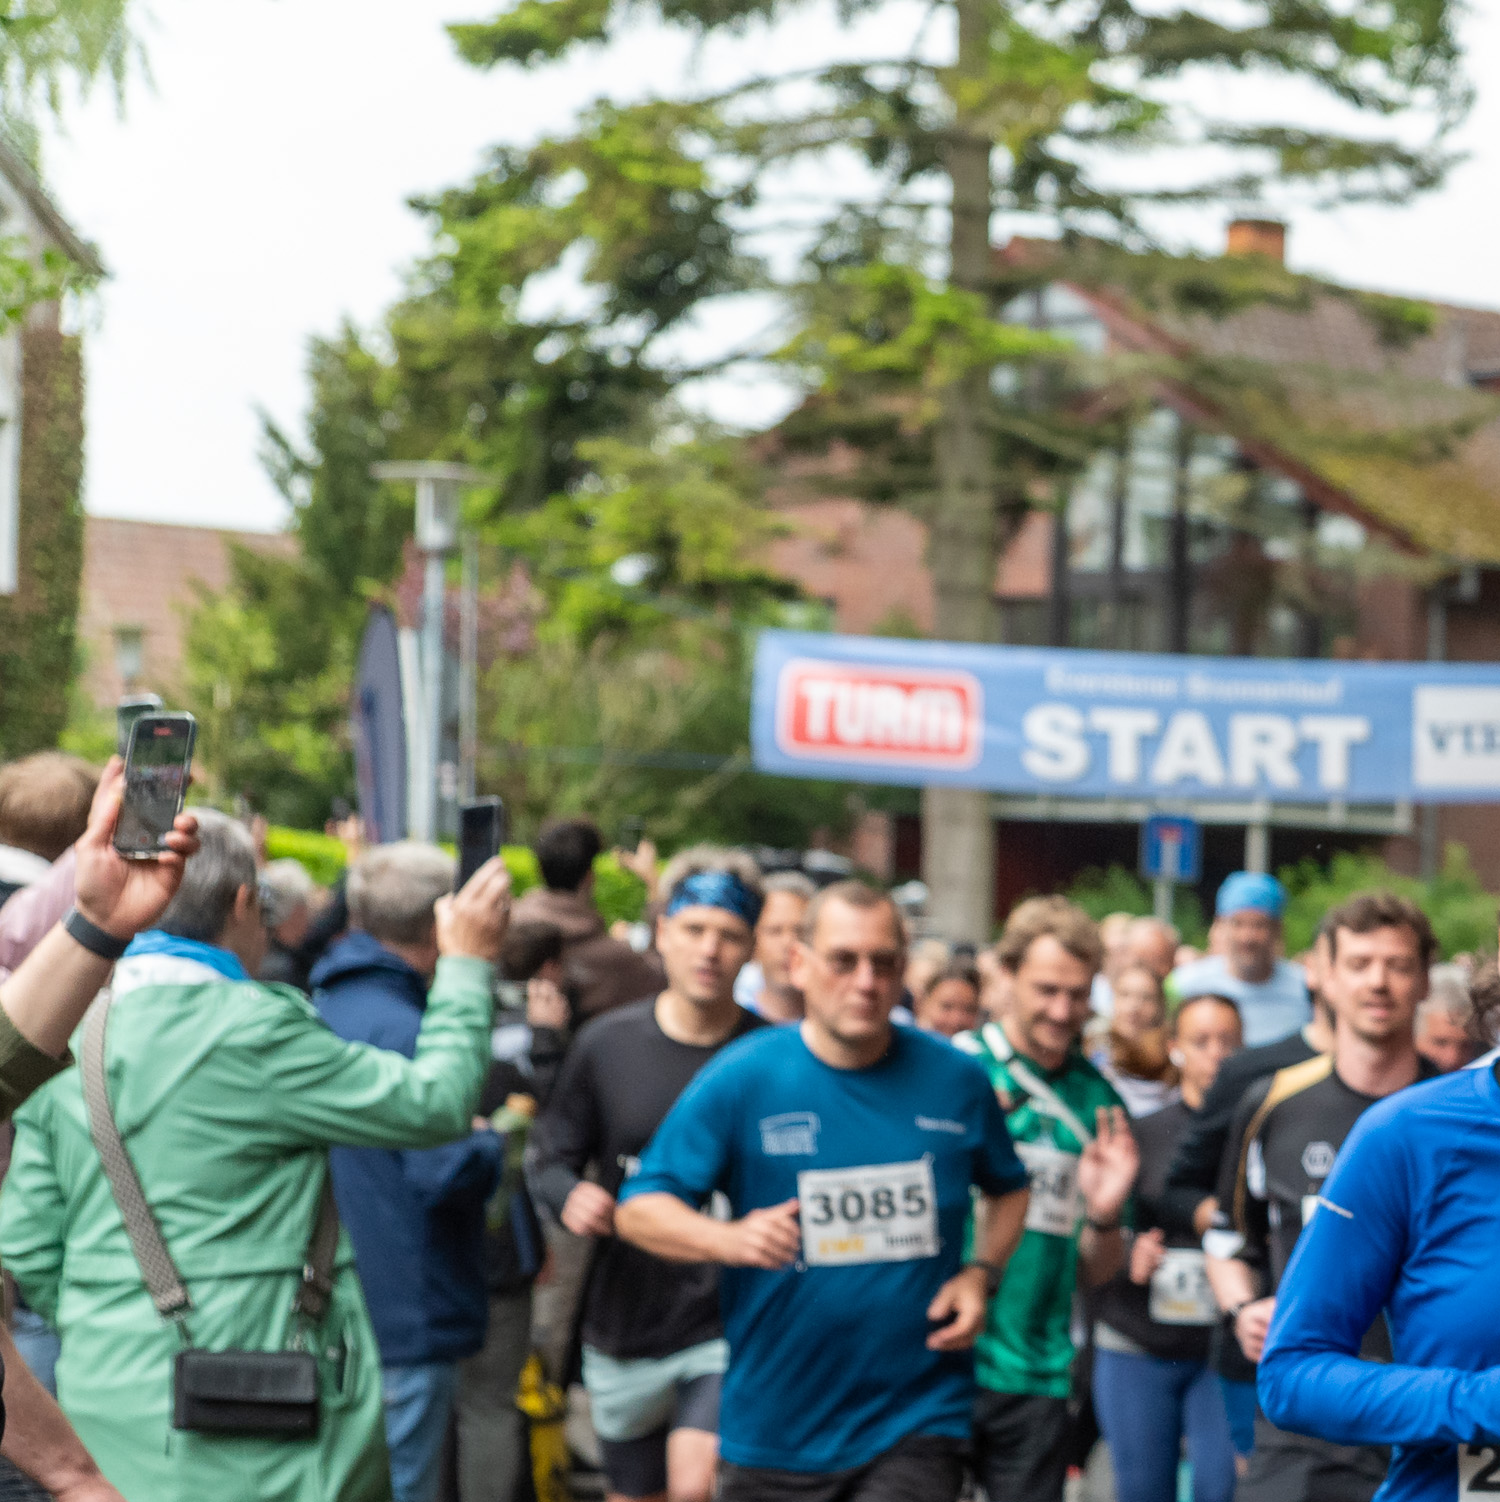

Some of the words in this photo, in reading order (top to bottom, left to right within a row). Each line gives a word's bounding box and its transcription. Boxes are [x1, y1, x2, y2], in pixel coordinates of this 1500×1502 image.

[800, 677, 966, 750] TURM
[1022, 702, 1373, 788] START
[809, 1184, 927, 1226] 3085
